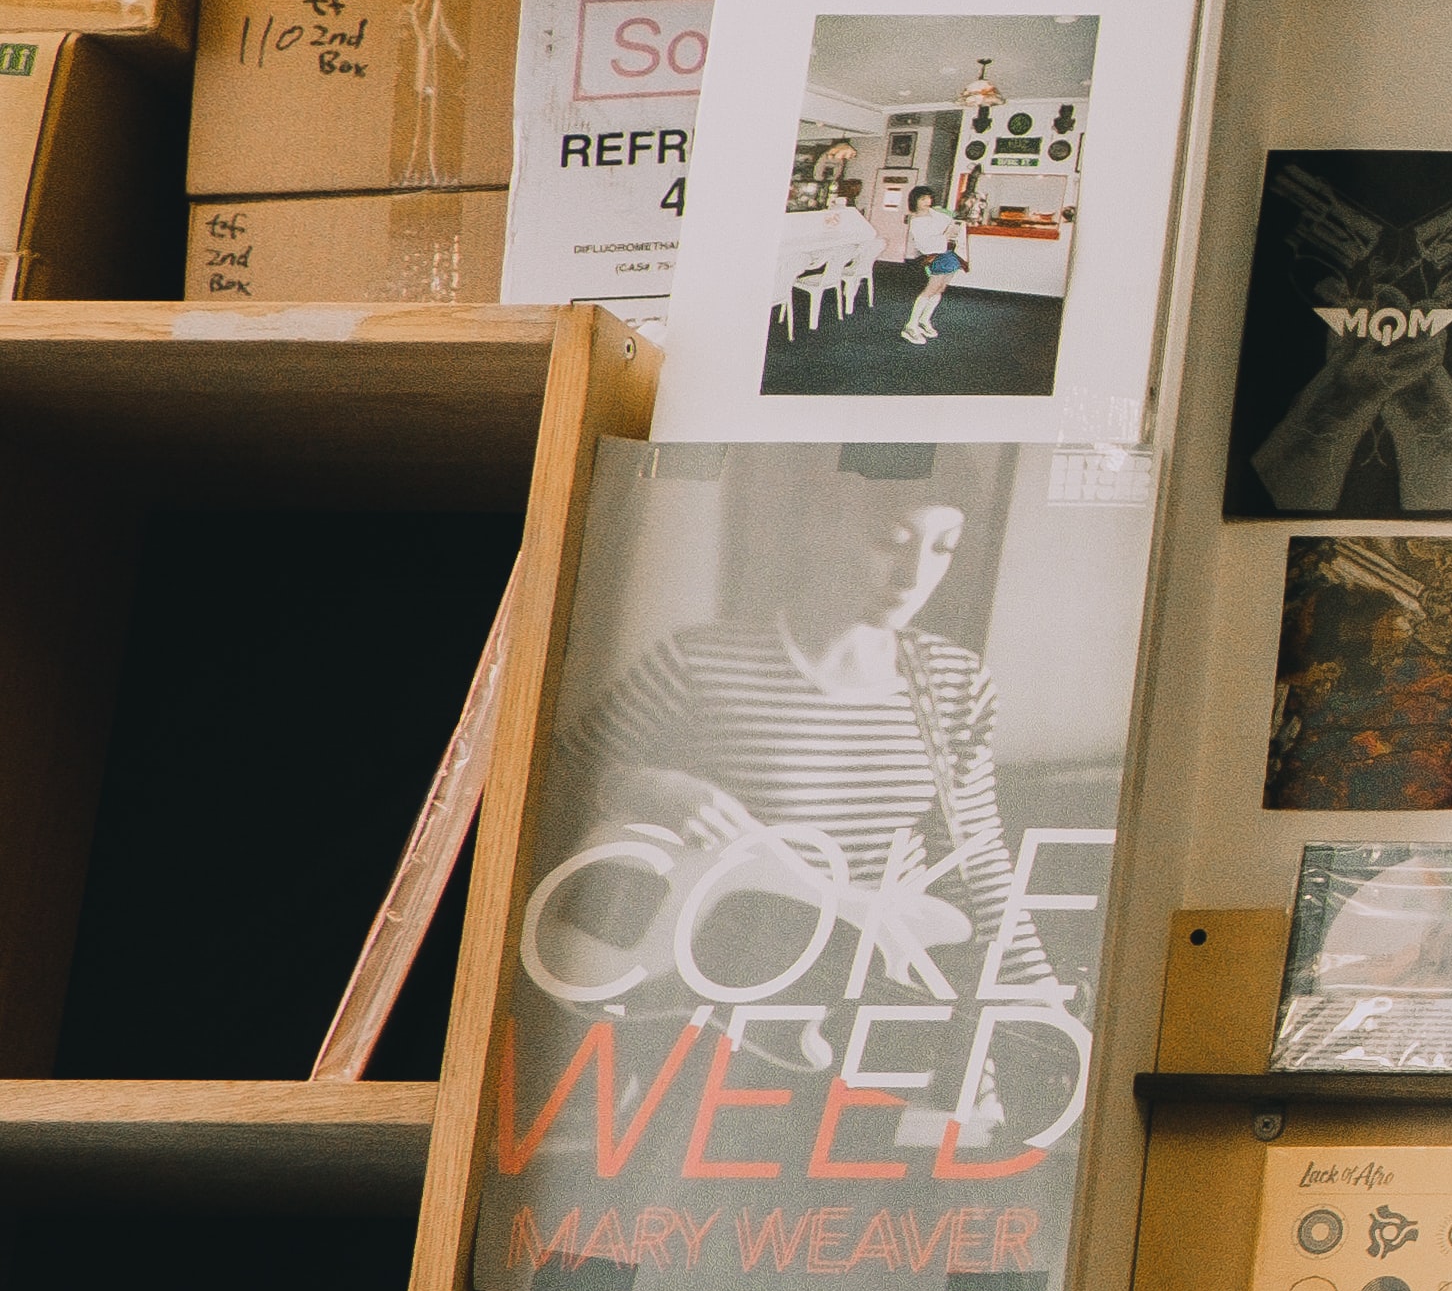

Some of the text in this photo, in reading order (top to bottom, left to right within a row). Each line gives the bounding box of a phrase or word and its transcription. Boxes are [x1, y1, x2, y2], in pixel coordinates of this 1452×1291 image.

[310, 17, 365, 52] 2nd
[318, 48, 367, 80] Box
[205, 246, 251, 271] 2nd
[208, 271, 254, 298] Box
[519, 823, 1118, 1004] COKE
[492, 1005, 1095, 1184] WEED
[1299, 1160, 1395, 1191] Lack Afro
[504, 1205, 1042, 1276] MARY WEAVER
